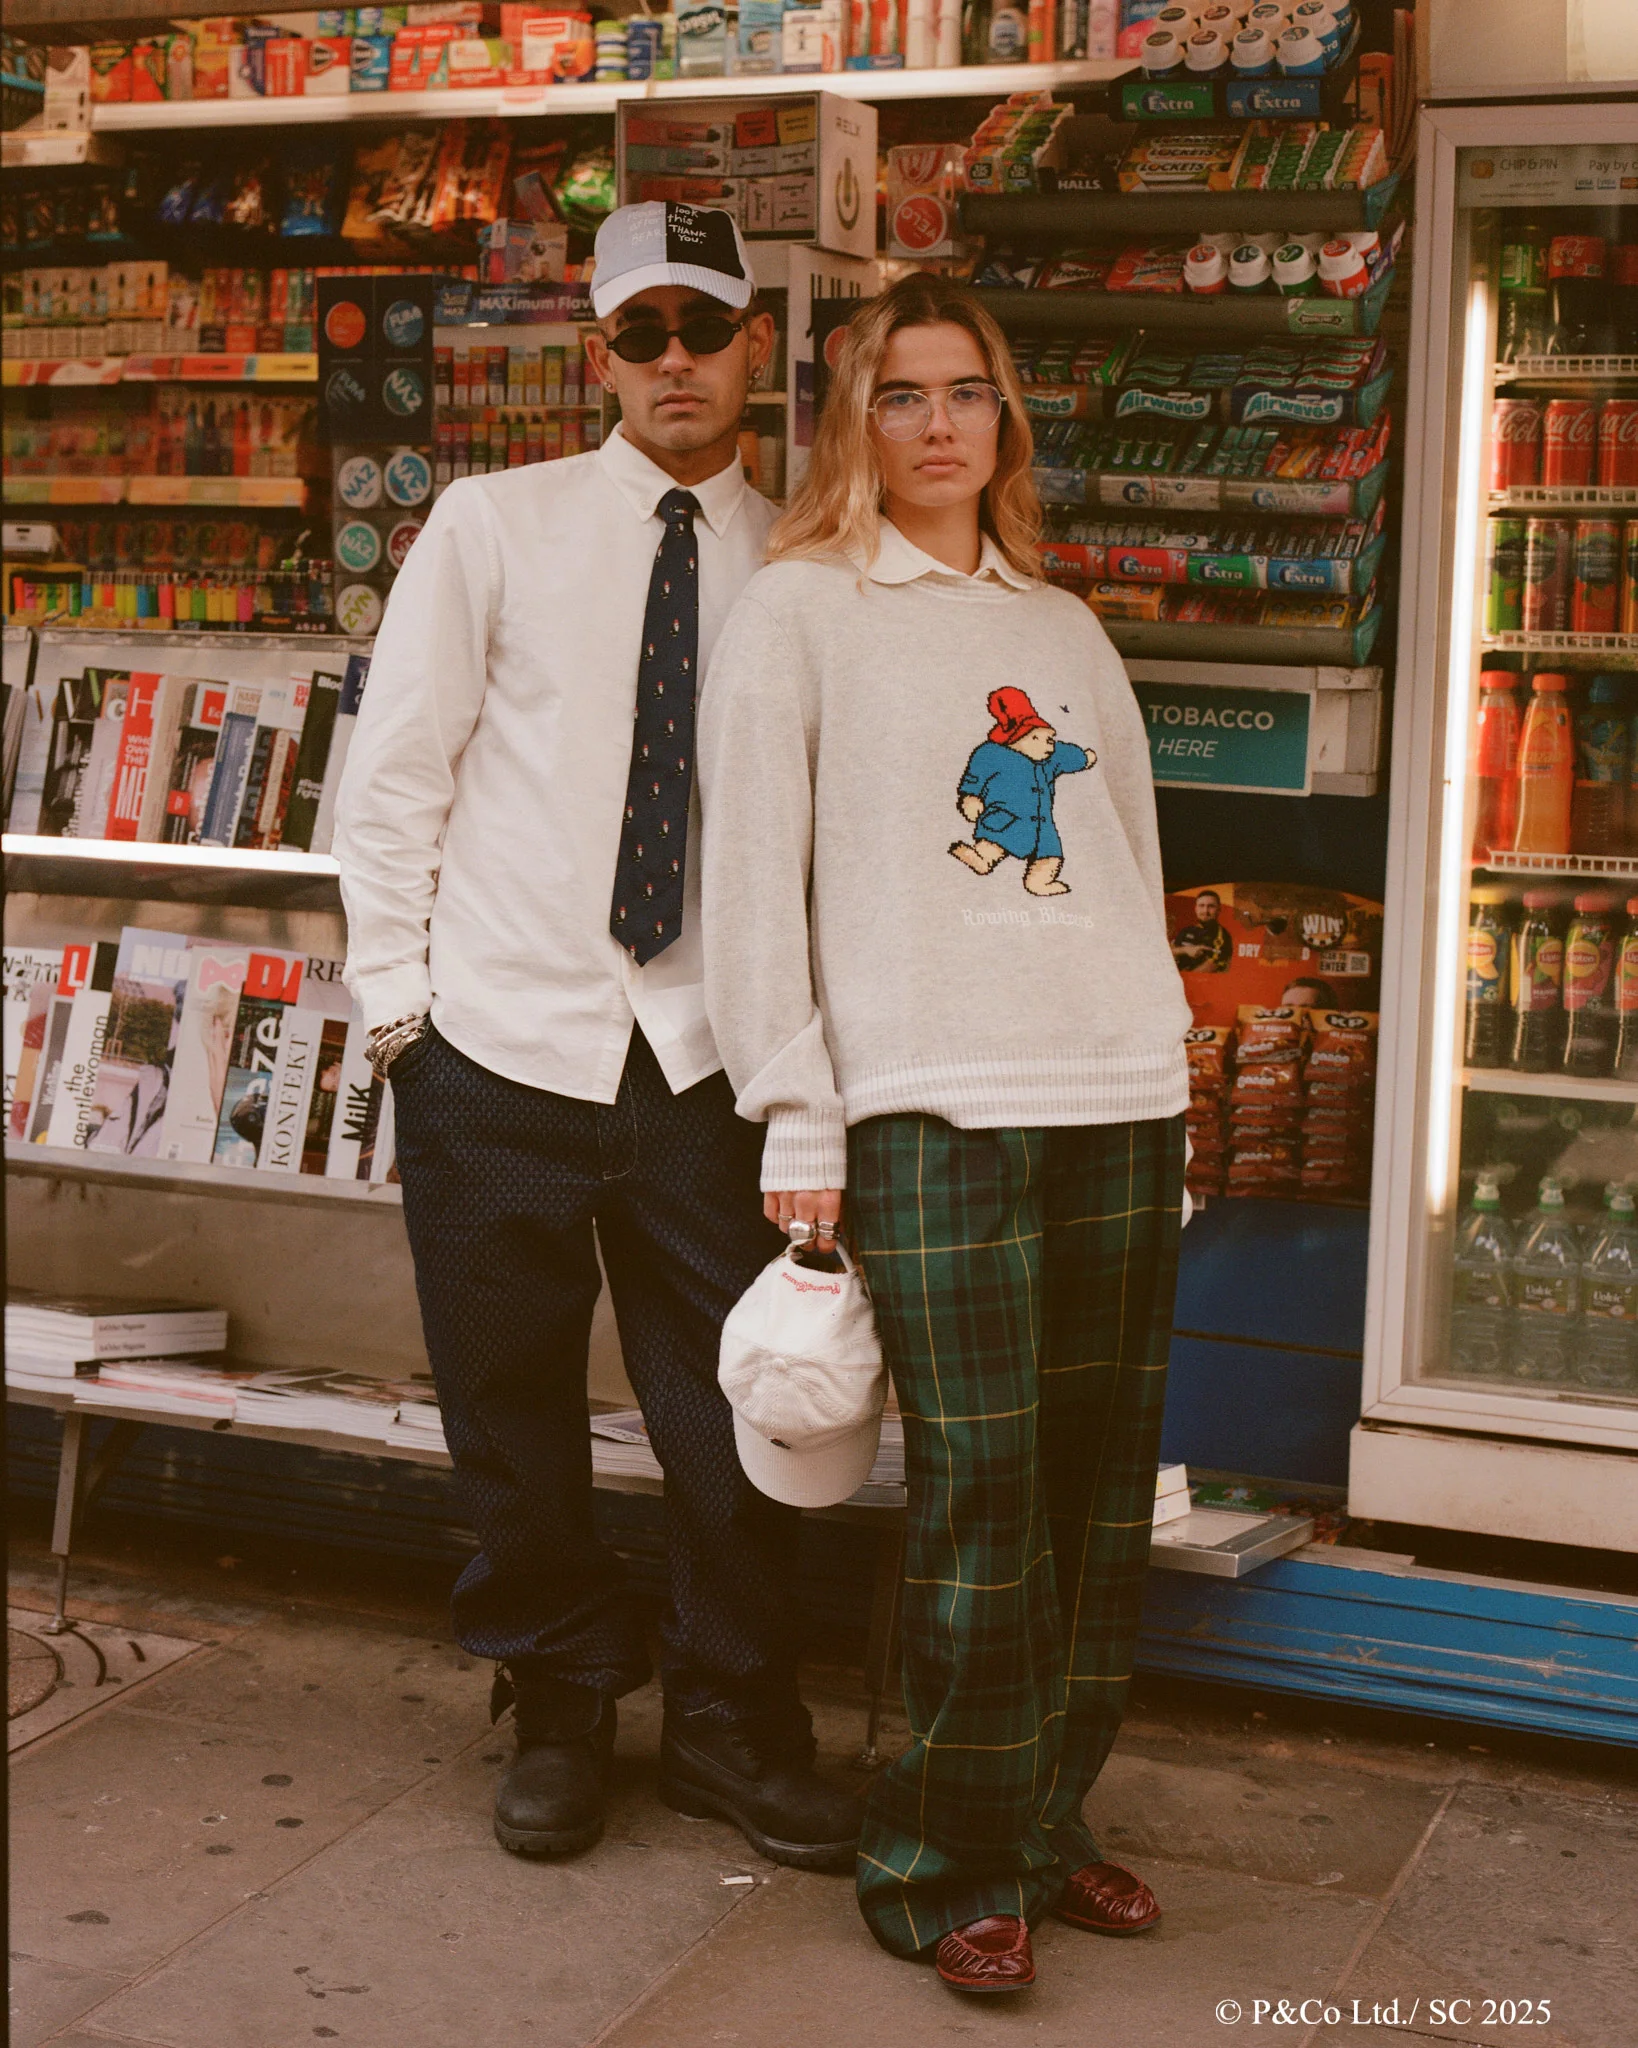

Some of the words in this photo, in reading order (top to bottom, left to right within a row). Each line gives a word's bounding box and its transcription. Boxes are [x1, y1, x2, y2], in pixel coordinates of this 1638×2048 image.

[1147, 93, 1194, 110] Extra
[1253, 92, 1300, 110] Extra
[1139, 163, 1205, 173] LOCKETS
[1588, 159, 1610, 173] Pay
[1613, 159, 1628, 172] by
[1058, 179, 1101, 190] HALLS
[667, 214, 694, 226] this
[668, 224, 707, 238] THANK
[479, 295, 556, 311] MAXimum
[1118, 392, 1205, 415] Airwaves
[1247, 393, 1336, 418] Airwaves
[1123, 558, 1162, 574] Extra
[1203, 564, 1243, 580] Extra
[1284, 569, 1325, 585] Extra
[1148, 705, 1274, 731] TOBACCO
[1157, 738, 1218, 758] HERE
[962, 907, 1030, 928] Rowing
[1302, 914, 1342, 935] WIN
[1238, 944, 1260, 957] DRY
[1320, 962, 1347, 972] ENTER
[1330, 1017, 1364, 1027] KP
[65, 1063, 85, 1093] the
[73, 1015, 110, 1146] gentlewoman
[270, 1032, 309, 1167] KONFEKT
